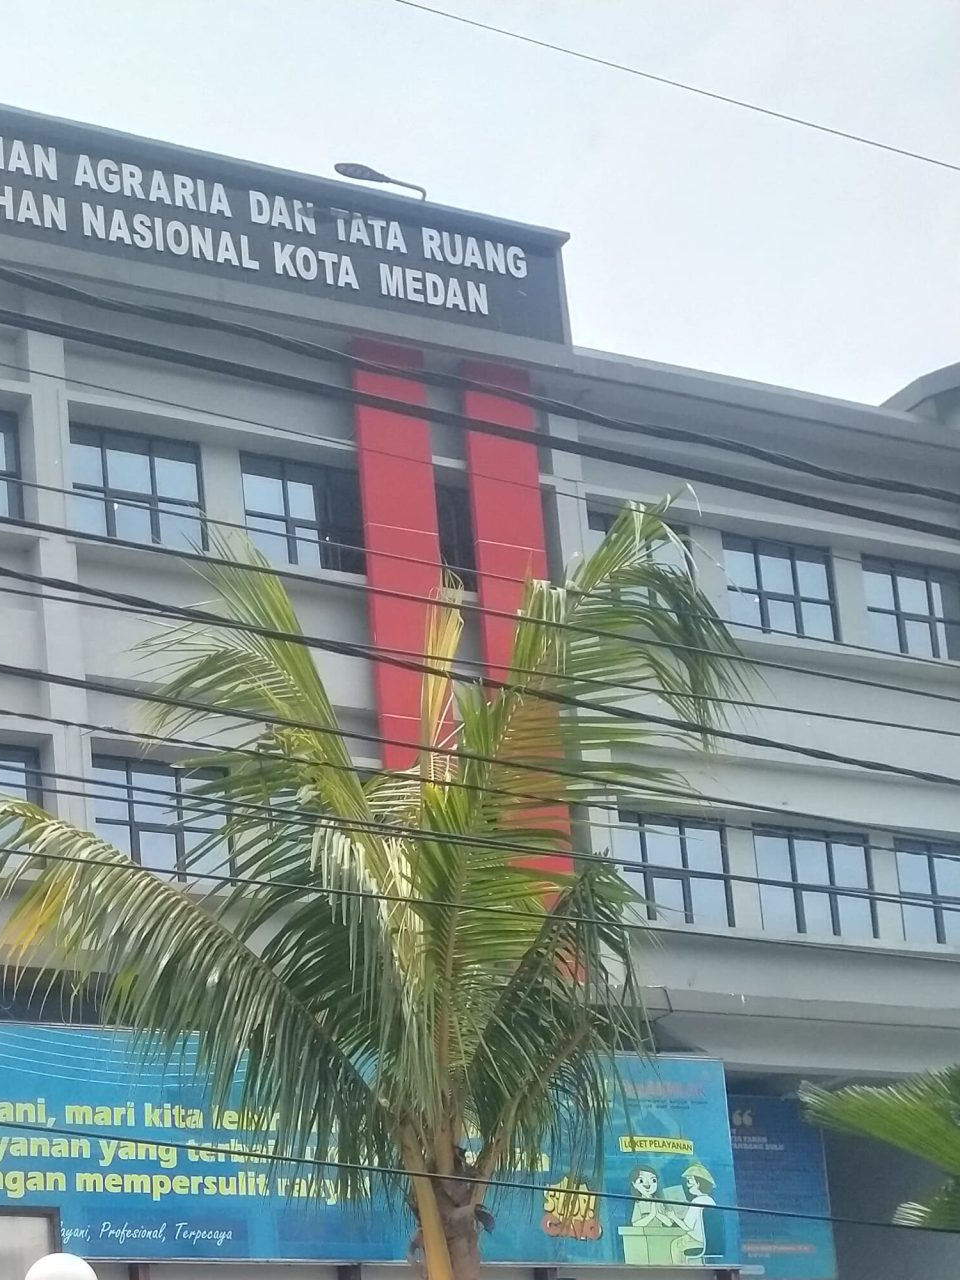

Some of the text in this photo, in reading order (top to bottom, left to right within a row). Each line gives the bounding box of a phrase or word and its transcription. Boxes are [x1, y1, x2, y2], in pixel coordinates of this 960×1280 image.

[74, 154, 233, 218] AGRARIA
[249, 190, 317, 236] DAN
[330, 207, 408, 255] TATA
[422, 226, 528, 279] RUANG
[82, 202, 260, 271] NASIONAL
[273, 241, 361, 290] KOTA
[379, 262, 489, 315] MEDAN
[65, 1101, 136, 1127] mari
[144, 1102, 204, 1129] kita
[98, 1138, 178, 1169] yang
[186, 1138, 292, 1166] terbai
[649, 1140, 693, 1153] PELAYANAN
[75, 1171, 270, 1202] mempersulit
[60, 1221, 91, 1243] ayani,
[99, 1221, 168, 1244] Profesional,
